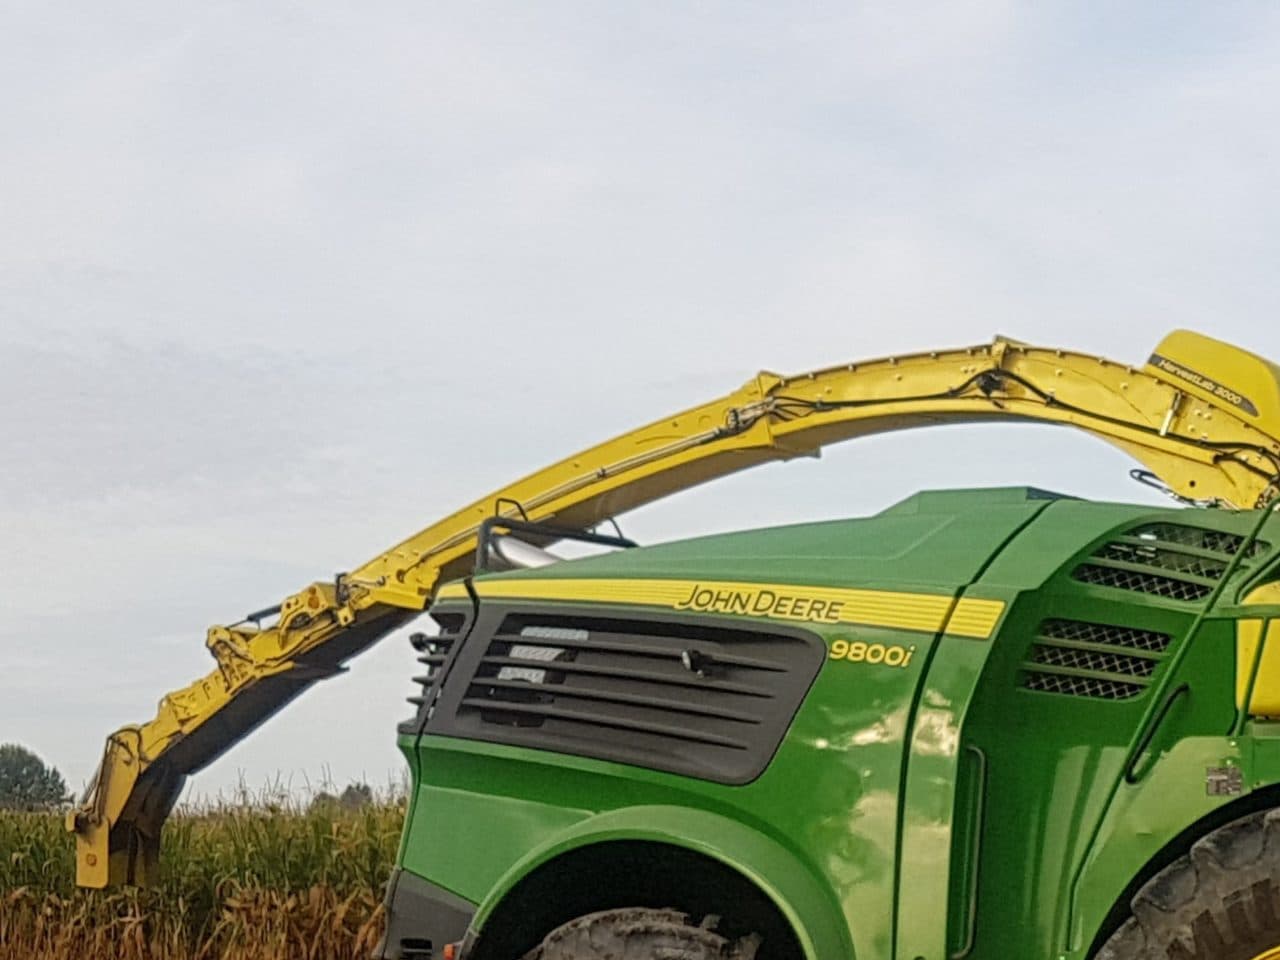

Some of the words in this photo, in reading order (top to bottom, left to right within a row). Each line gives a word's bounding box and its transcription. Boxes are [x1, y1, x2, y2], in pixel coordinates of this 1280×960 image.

[1158, 359, 1214, 391] HarvestLab
[1214, 386, 1242, 405] 3000
[678, 584, 751, 612] JOHN
[752, 590, 845, 621] DEERE
[829, 638, 916, 668] 9800i
